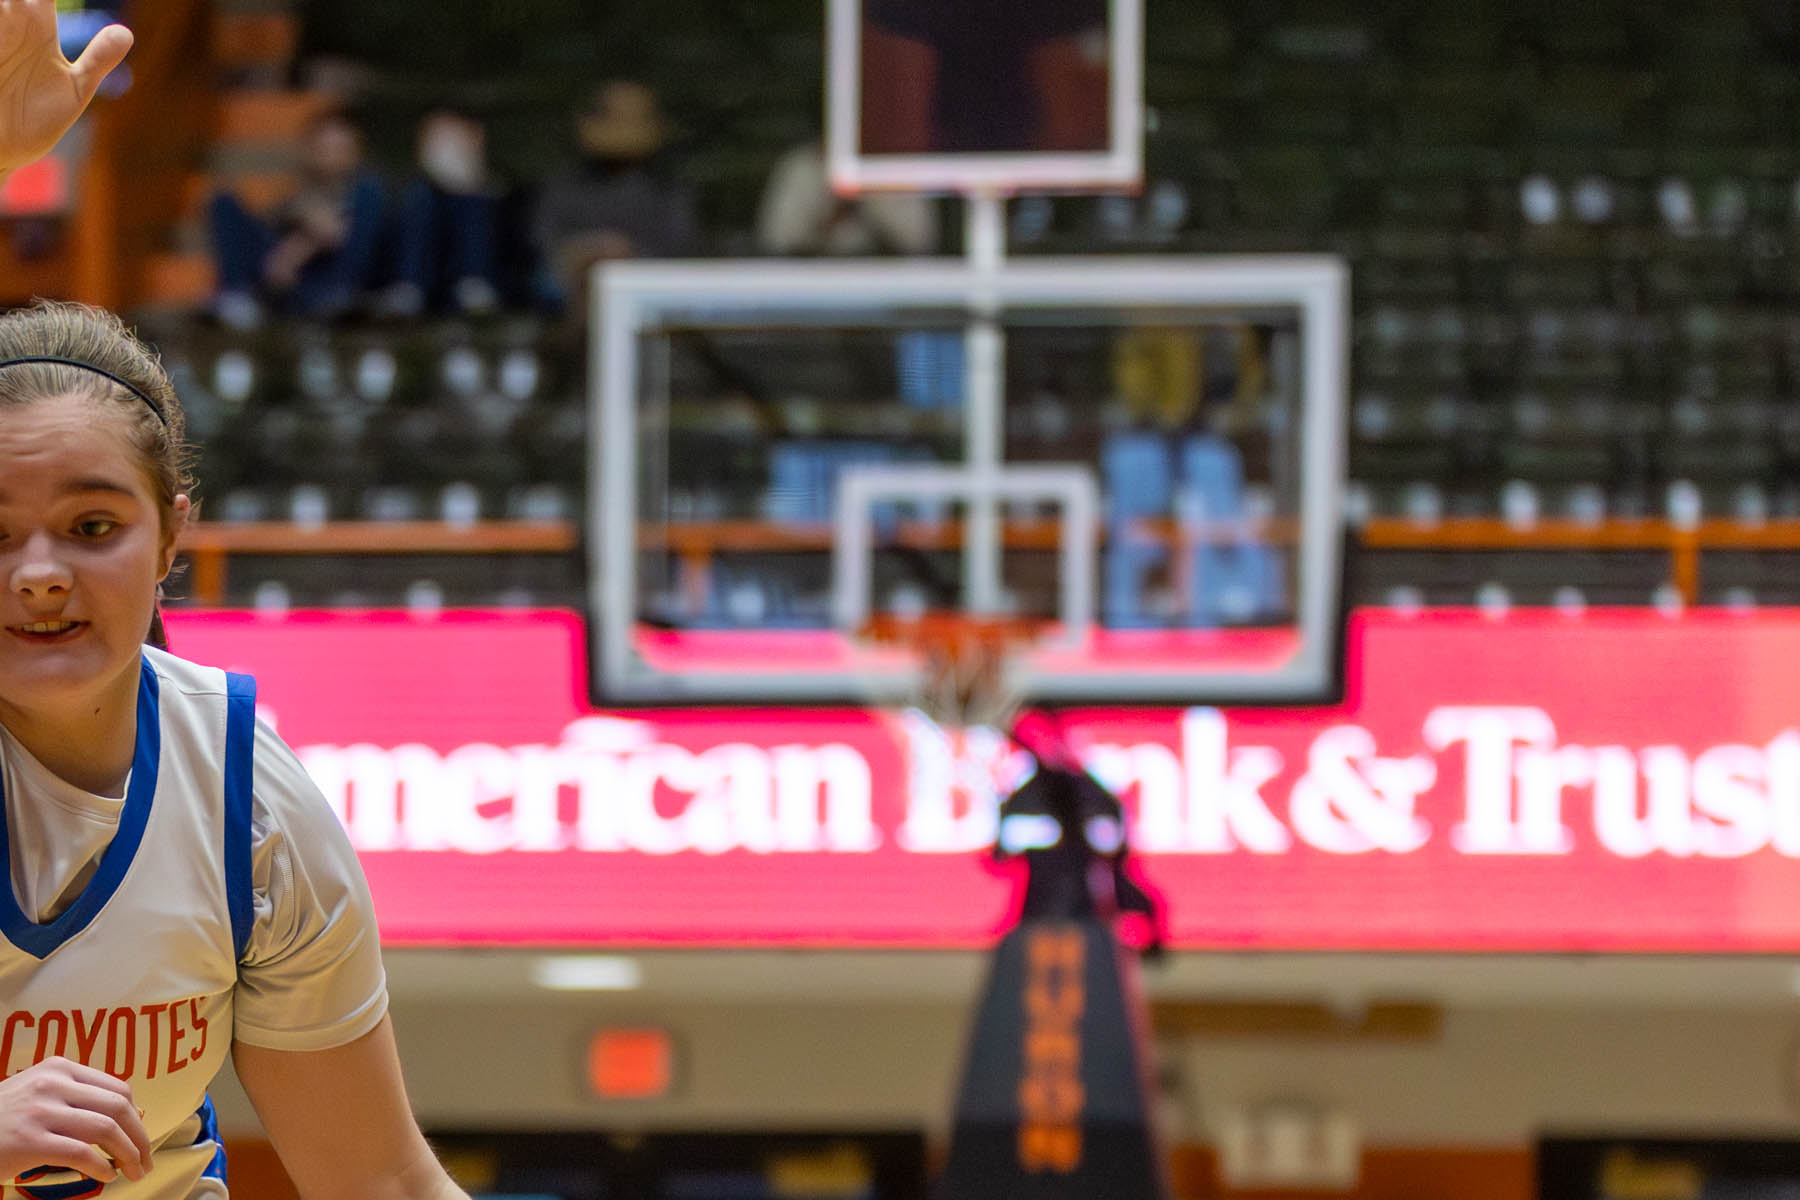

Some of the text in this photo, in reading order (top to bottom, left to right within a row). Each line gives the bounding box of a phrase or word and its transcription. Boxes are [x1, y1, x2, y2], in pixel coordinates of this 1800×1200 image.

[255, 705, 884, 853] merican
[896, 706, 1294, 852] Bnk
[1289, 723, 1437, 853] &
